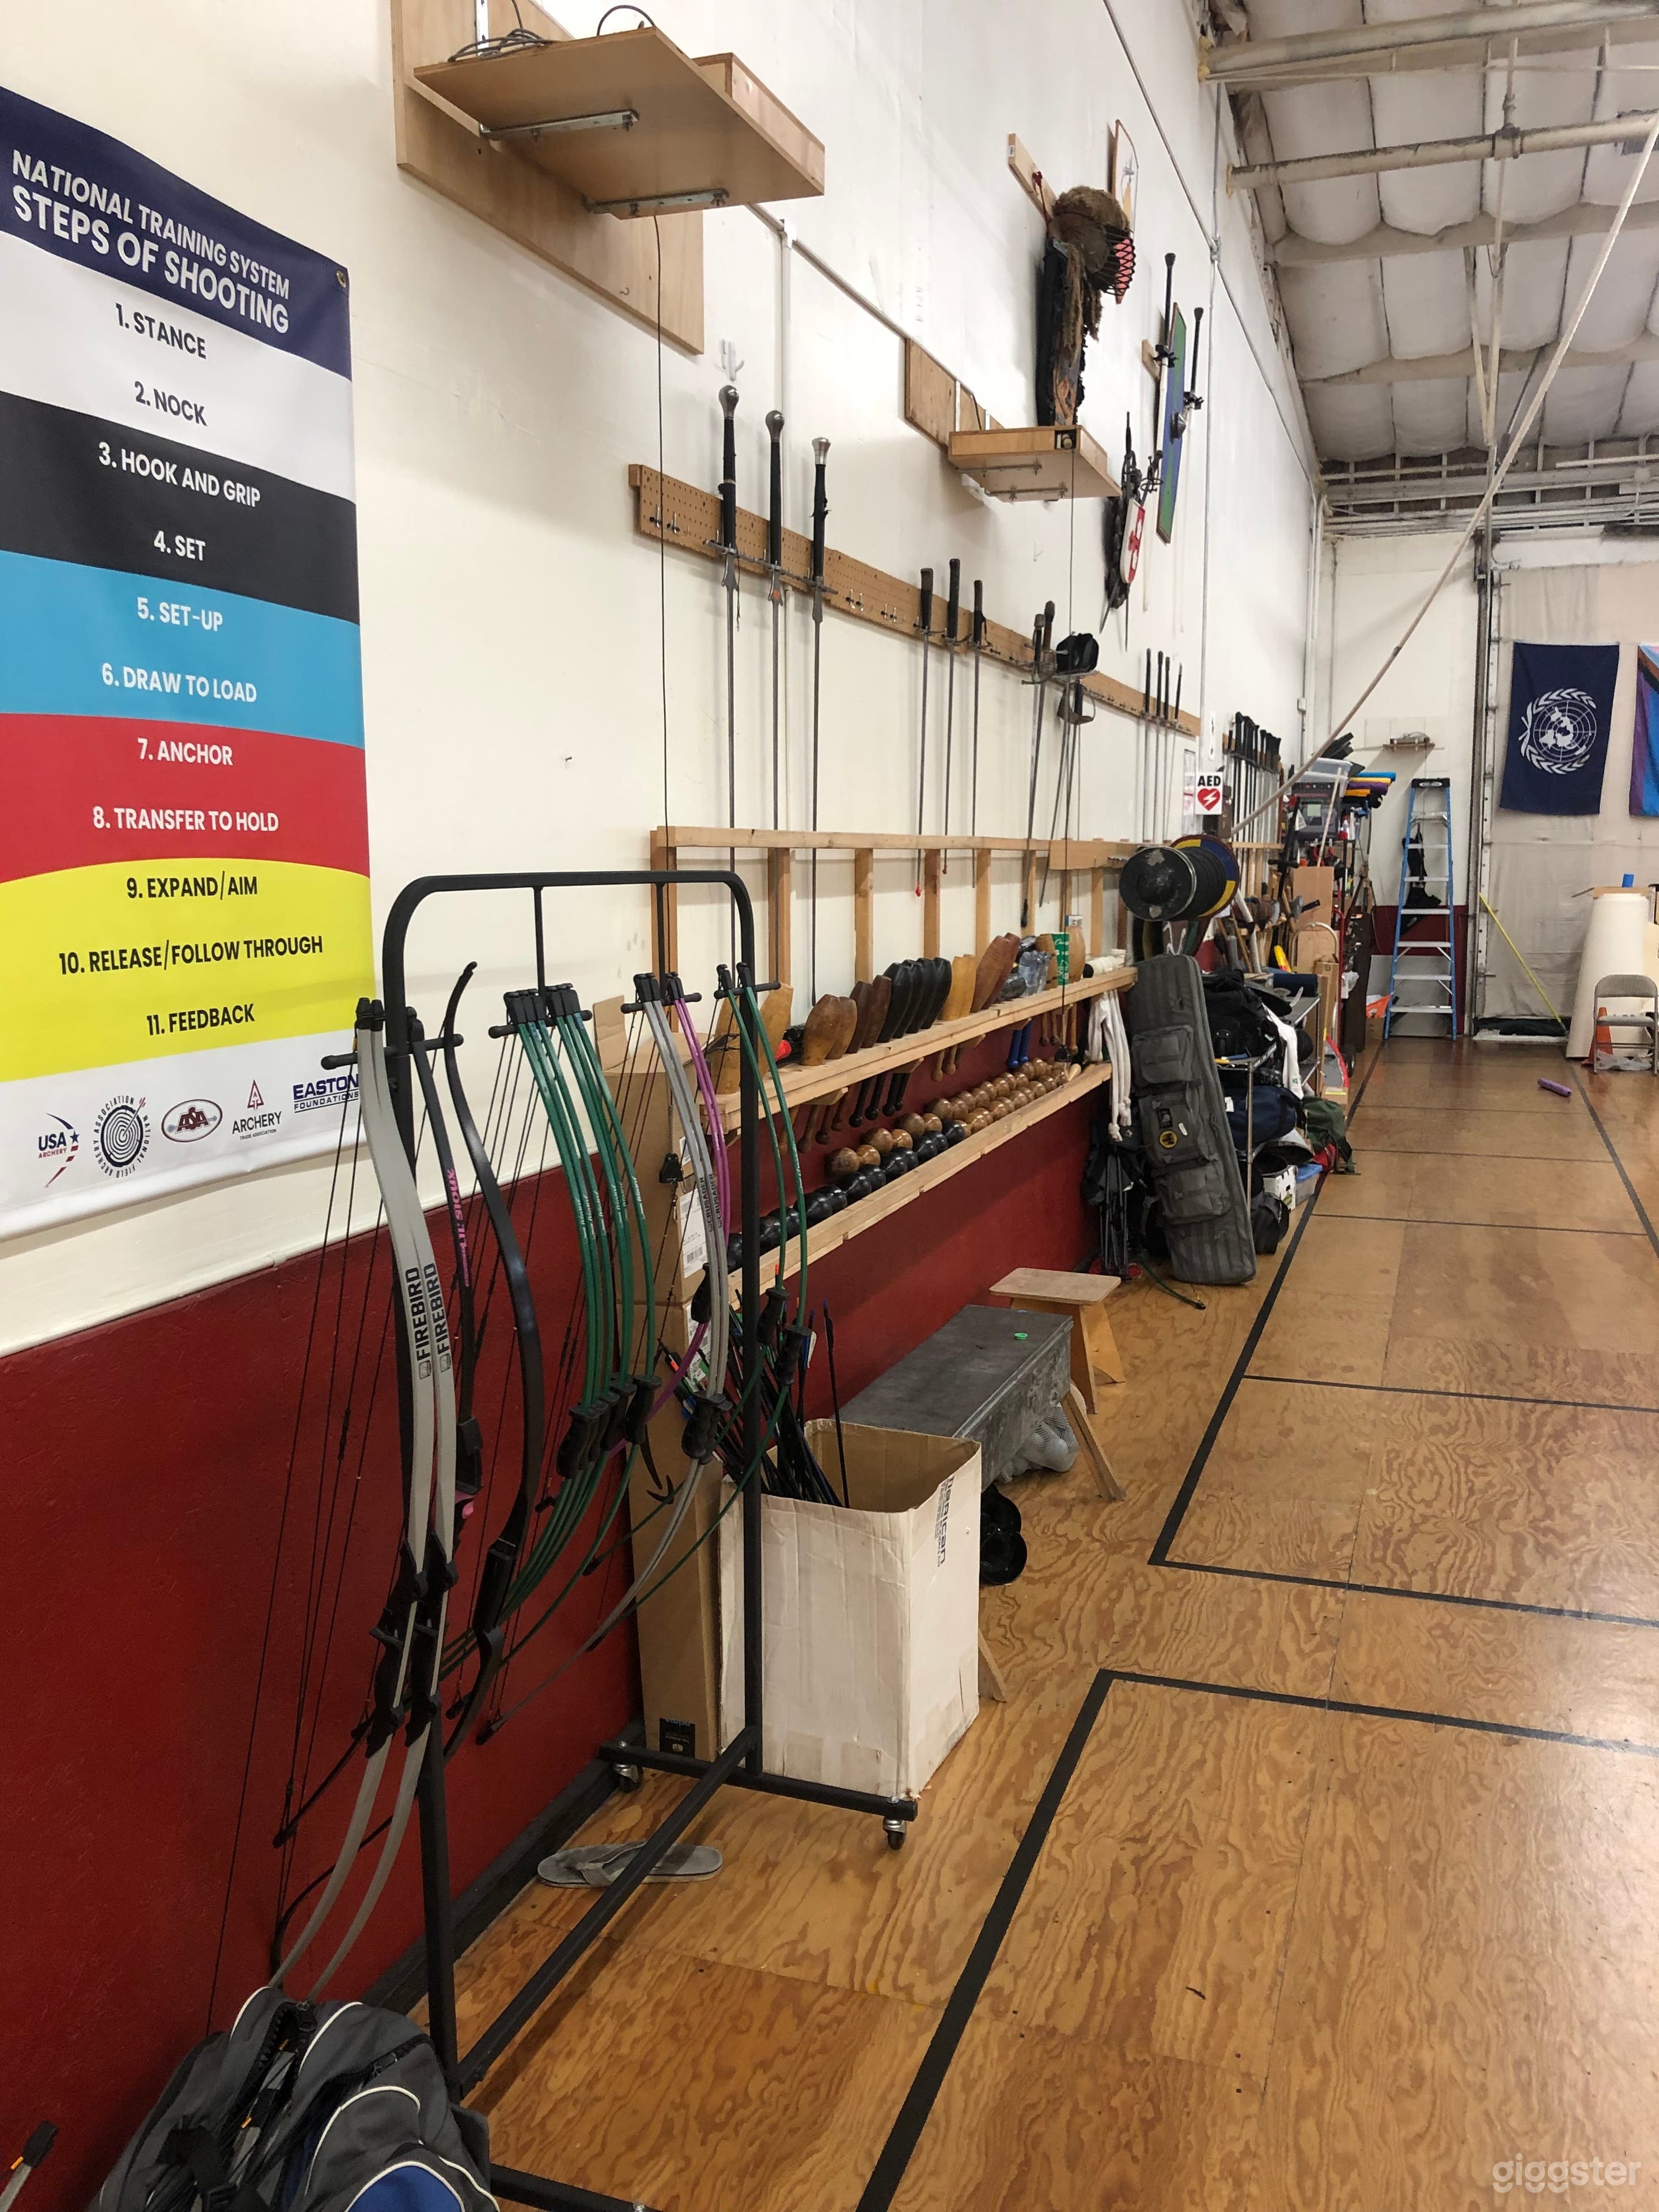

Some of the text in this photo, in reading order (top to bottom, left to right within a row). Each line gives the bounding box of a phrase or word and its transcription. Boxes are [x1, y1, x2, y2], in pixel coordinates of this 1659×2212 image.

[13, 149, 290, 300] NATIONAL TRAINING SYSTEM
[13, 184, 289, 334] STEPS OF SHOOTING
[115, 302, 207, 359] 1. STANCE
[134, 381, 207, 427] 2. NOCK
[99, 441, 261, 507] 3. HOOK AND GRIP
[153, 530, 206, 561] 4. SET
[137, 596, 224, 632] 5. SET-UP
[101, 662, 257, 703] 6. DRAW TO LOAD
[137, 737, 233, 766] 7. ANCHOR
[1197, 775, 1221, 787] AED
[92, 806, 279, 832] 8. TRANSFER TO HOLD
[126, 870, 258, 900] 9. EXPAND/AIM
[59, 935, 323, 975] 10. RELEASE/FOLLOW THROUGH
[146, 1003, 255, 1036] 11. FEEDBACK
[293, 1073, 359, 1100] EASTON
[294, 1091, 359, 1111] FOUNDATIONS
[38, 1131, 67, 1152] USA
[93, 1095, 151, 1179] NATIONAL FIELD ARCHERY ASSOCIATION
[232, 1111, 282, 1134] ARCHERY
[239, 1128, 277, 1141] TRADE ASSOCIATION
[38, 1147, 67, 1159] ARCHERY
[446, 1168, 463, 1220] SIOUX
[699, 1177, 713, 1224] CRUSADER
[709, 1173, 722, 1219] CRUSADER
[405, 1267, 431, 1361] FIREBIRD
[424, 1262, 450, 1355] FIREBIRD
